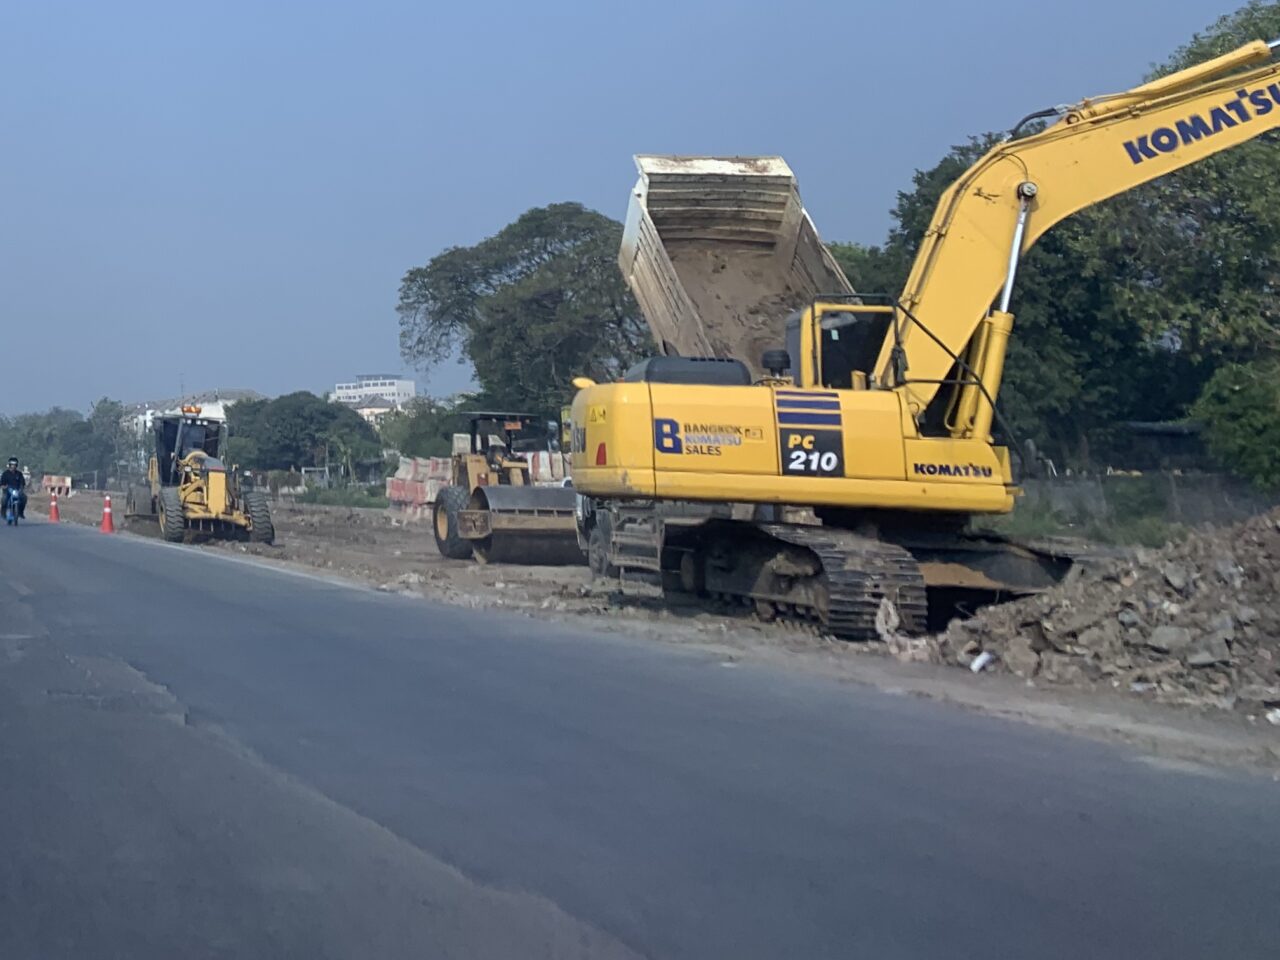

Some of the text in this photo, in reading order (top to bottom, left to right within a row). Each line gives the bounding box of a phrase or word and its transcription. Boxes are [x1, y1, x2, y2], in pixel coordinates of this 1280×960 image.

[684, 423, 742, 435] BANGKOK
[684, 434, 742, 446] KOMATSU
[788, 434, 814, 449] PC
[685, 445, 721, 456] SALES
[788, 451, 838, 472] 210
[914, 462, 992, 477] KOMATSU
